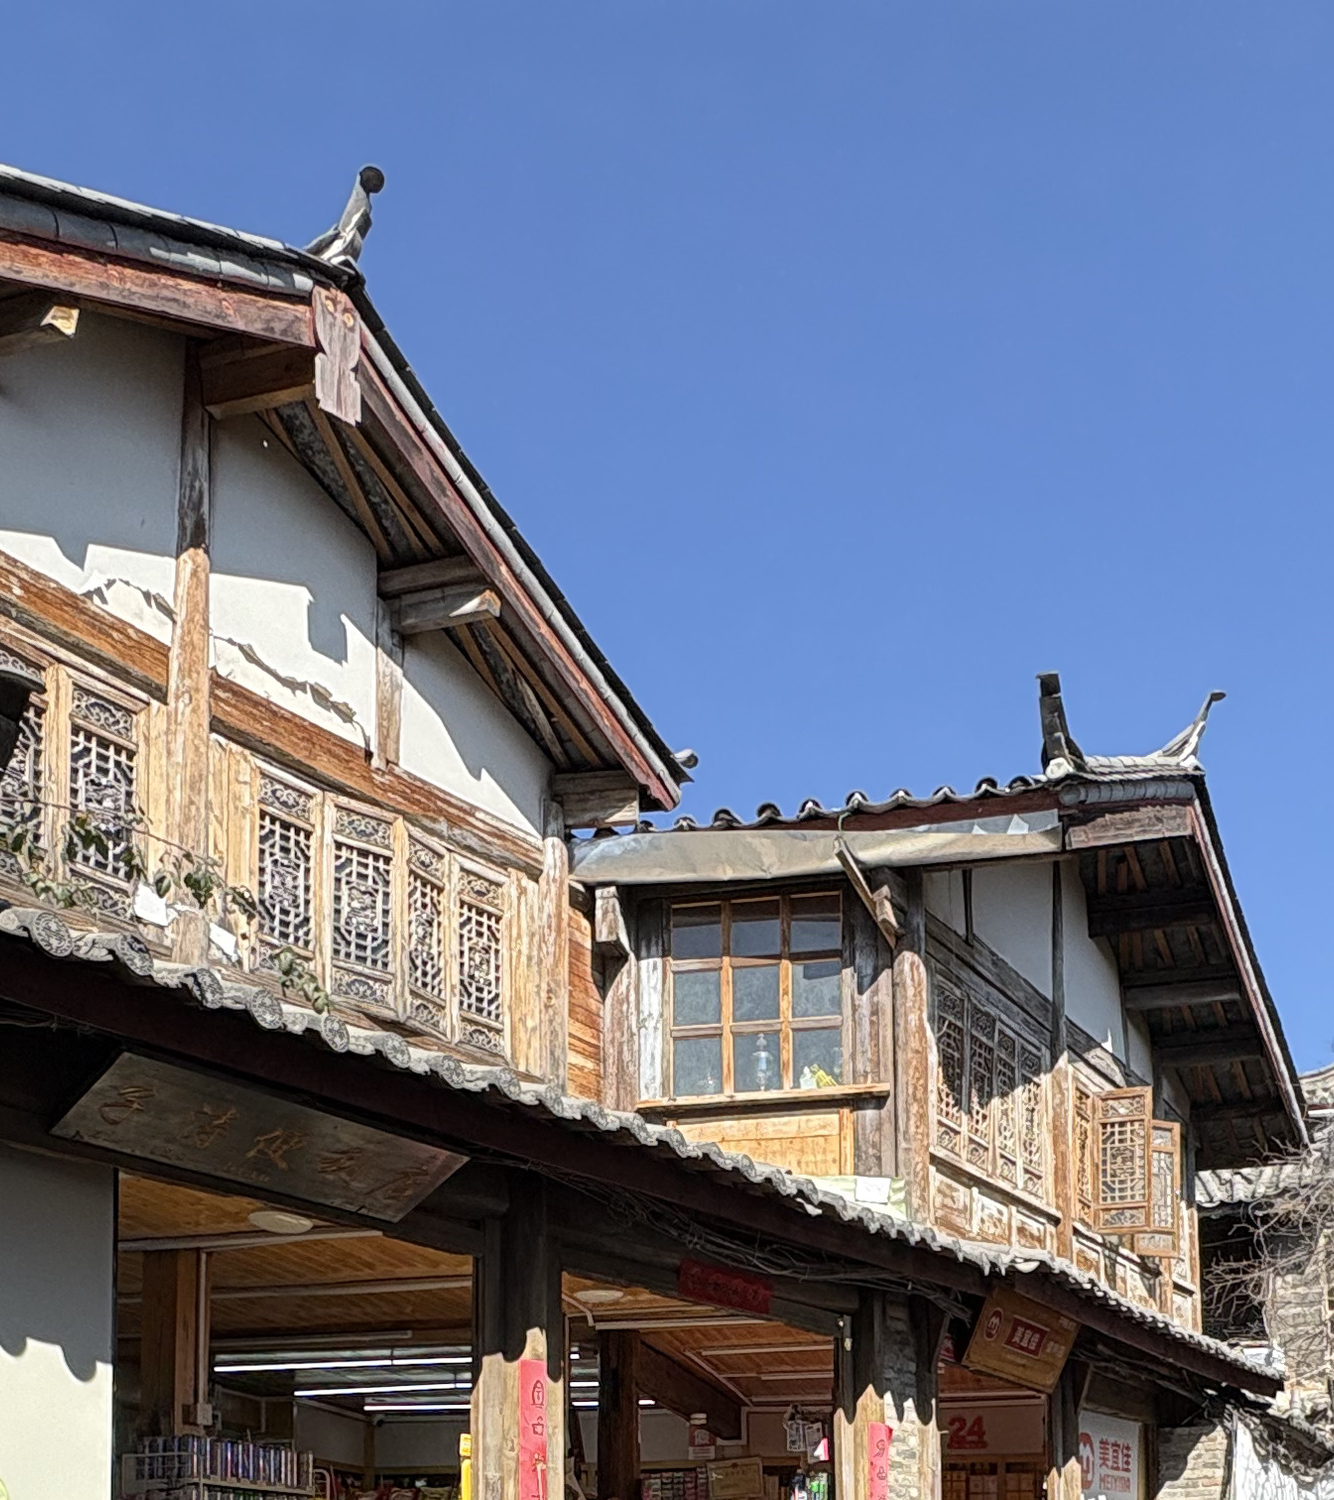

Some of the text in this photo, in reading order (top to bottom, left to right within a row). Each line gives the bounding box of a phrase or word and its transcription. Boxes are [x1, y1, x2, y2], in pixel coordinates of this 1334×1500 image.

[948, 1415, 986, 1441] 24
[1098, 1437, 1132, 1473] 美宜佳
